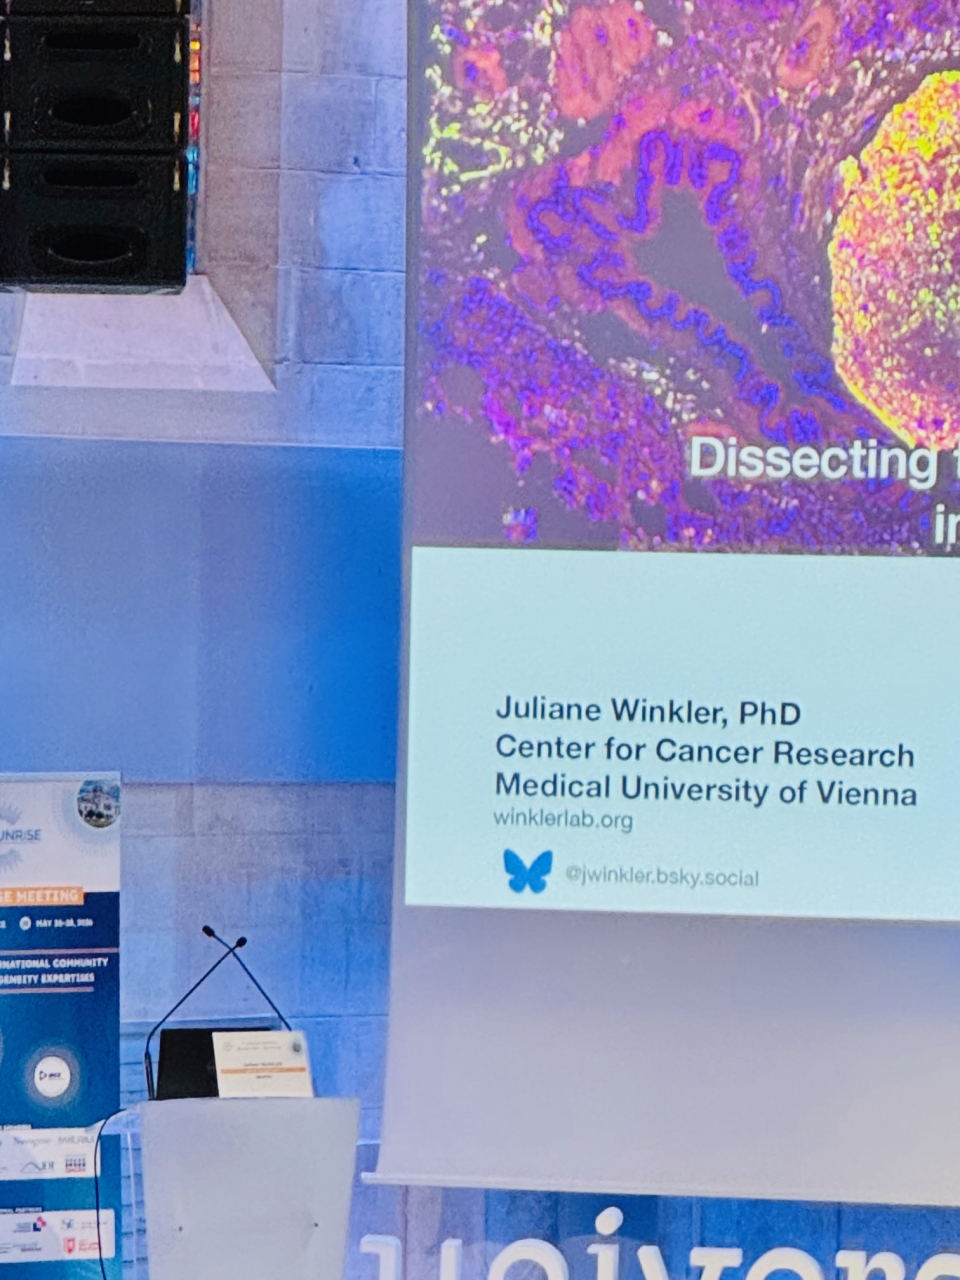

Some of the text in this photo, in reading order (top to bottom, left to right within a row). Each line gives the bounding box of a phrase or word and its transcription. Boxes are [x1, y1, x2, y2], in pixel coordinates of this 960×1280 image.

[690, 435, 938, 490] Dissecting
[495, 694, 802, 730] Juliane Winkler, PhD
[495, 733, 915, 768] Center for Cancer Research
[495, 771, 918, 809] Medical University of Vienna
[493, 807, 634, 834] winklerlab.org
[565, 864, 760, 889] @jwinkler.bsky.social
[16, 889, 78, 903] MEETING
[52, 957, 109, 968] COMMUNITY
[40, 973, 95, 984] EXPERTISES
